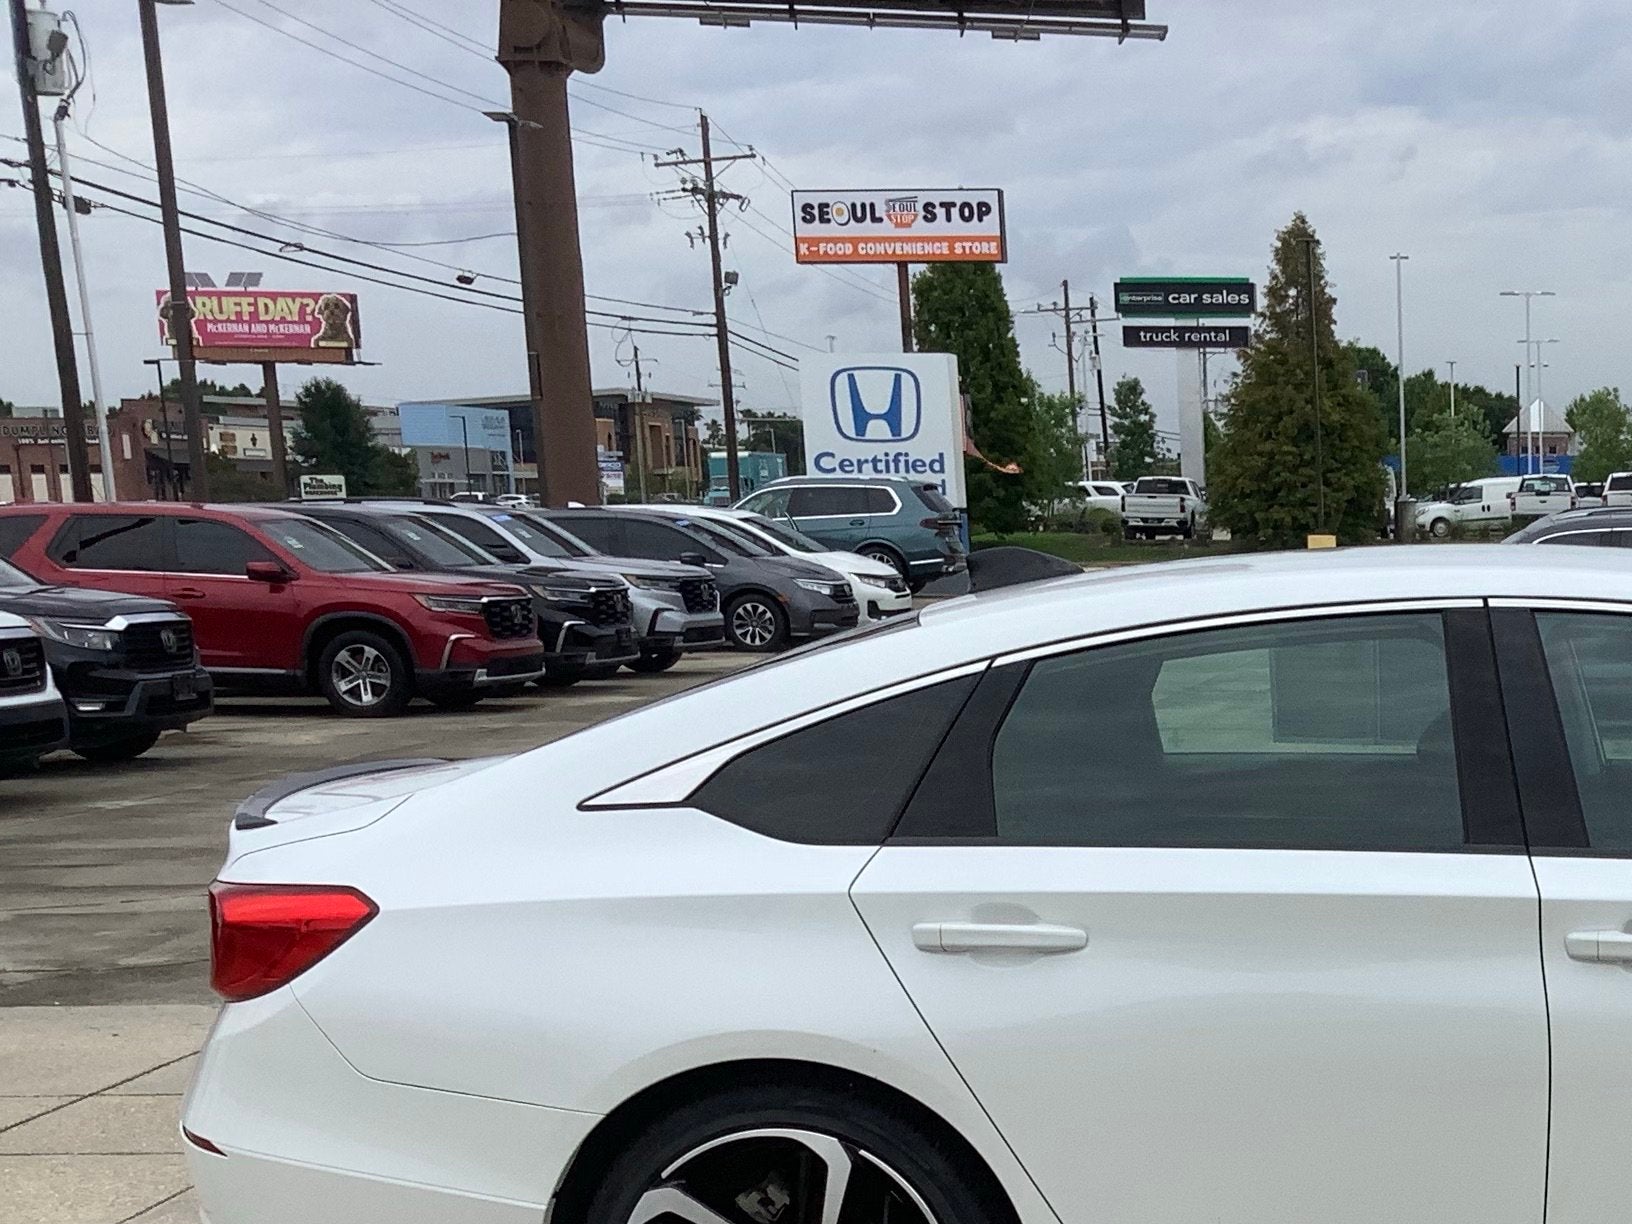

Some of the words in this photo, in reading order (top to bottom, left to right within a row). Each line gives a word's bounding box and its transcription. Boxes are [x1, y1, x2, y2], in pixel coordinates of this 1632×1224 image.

[800, 200, 884, 226] SEOUL
[922, 201, 992, 223] STOP
[799, 242, 853, 256] K-FOOD
[857, 242, 950, 256] CONVENIENCE
[953, 241, 998, 255] STORE
[1168, 293, 1198, 304] car
[1202, 290, 1250, 304] sales
[195, 295, 255, 321] RUFF
[258, 296, 315, 322] DAY?
[250, 322, 268, 334] AND
[1139, 329, 1180, 342] truck
[1184, 329, 1230, 342] rental
[813, 451, 946, 475] Certified
